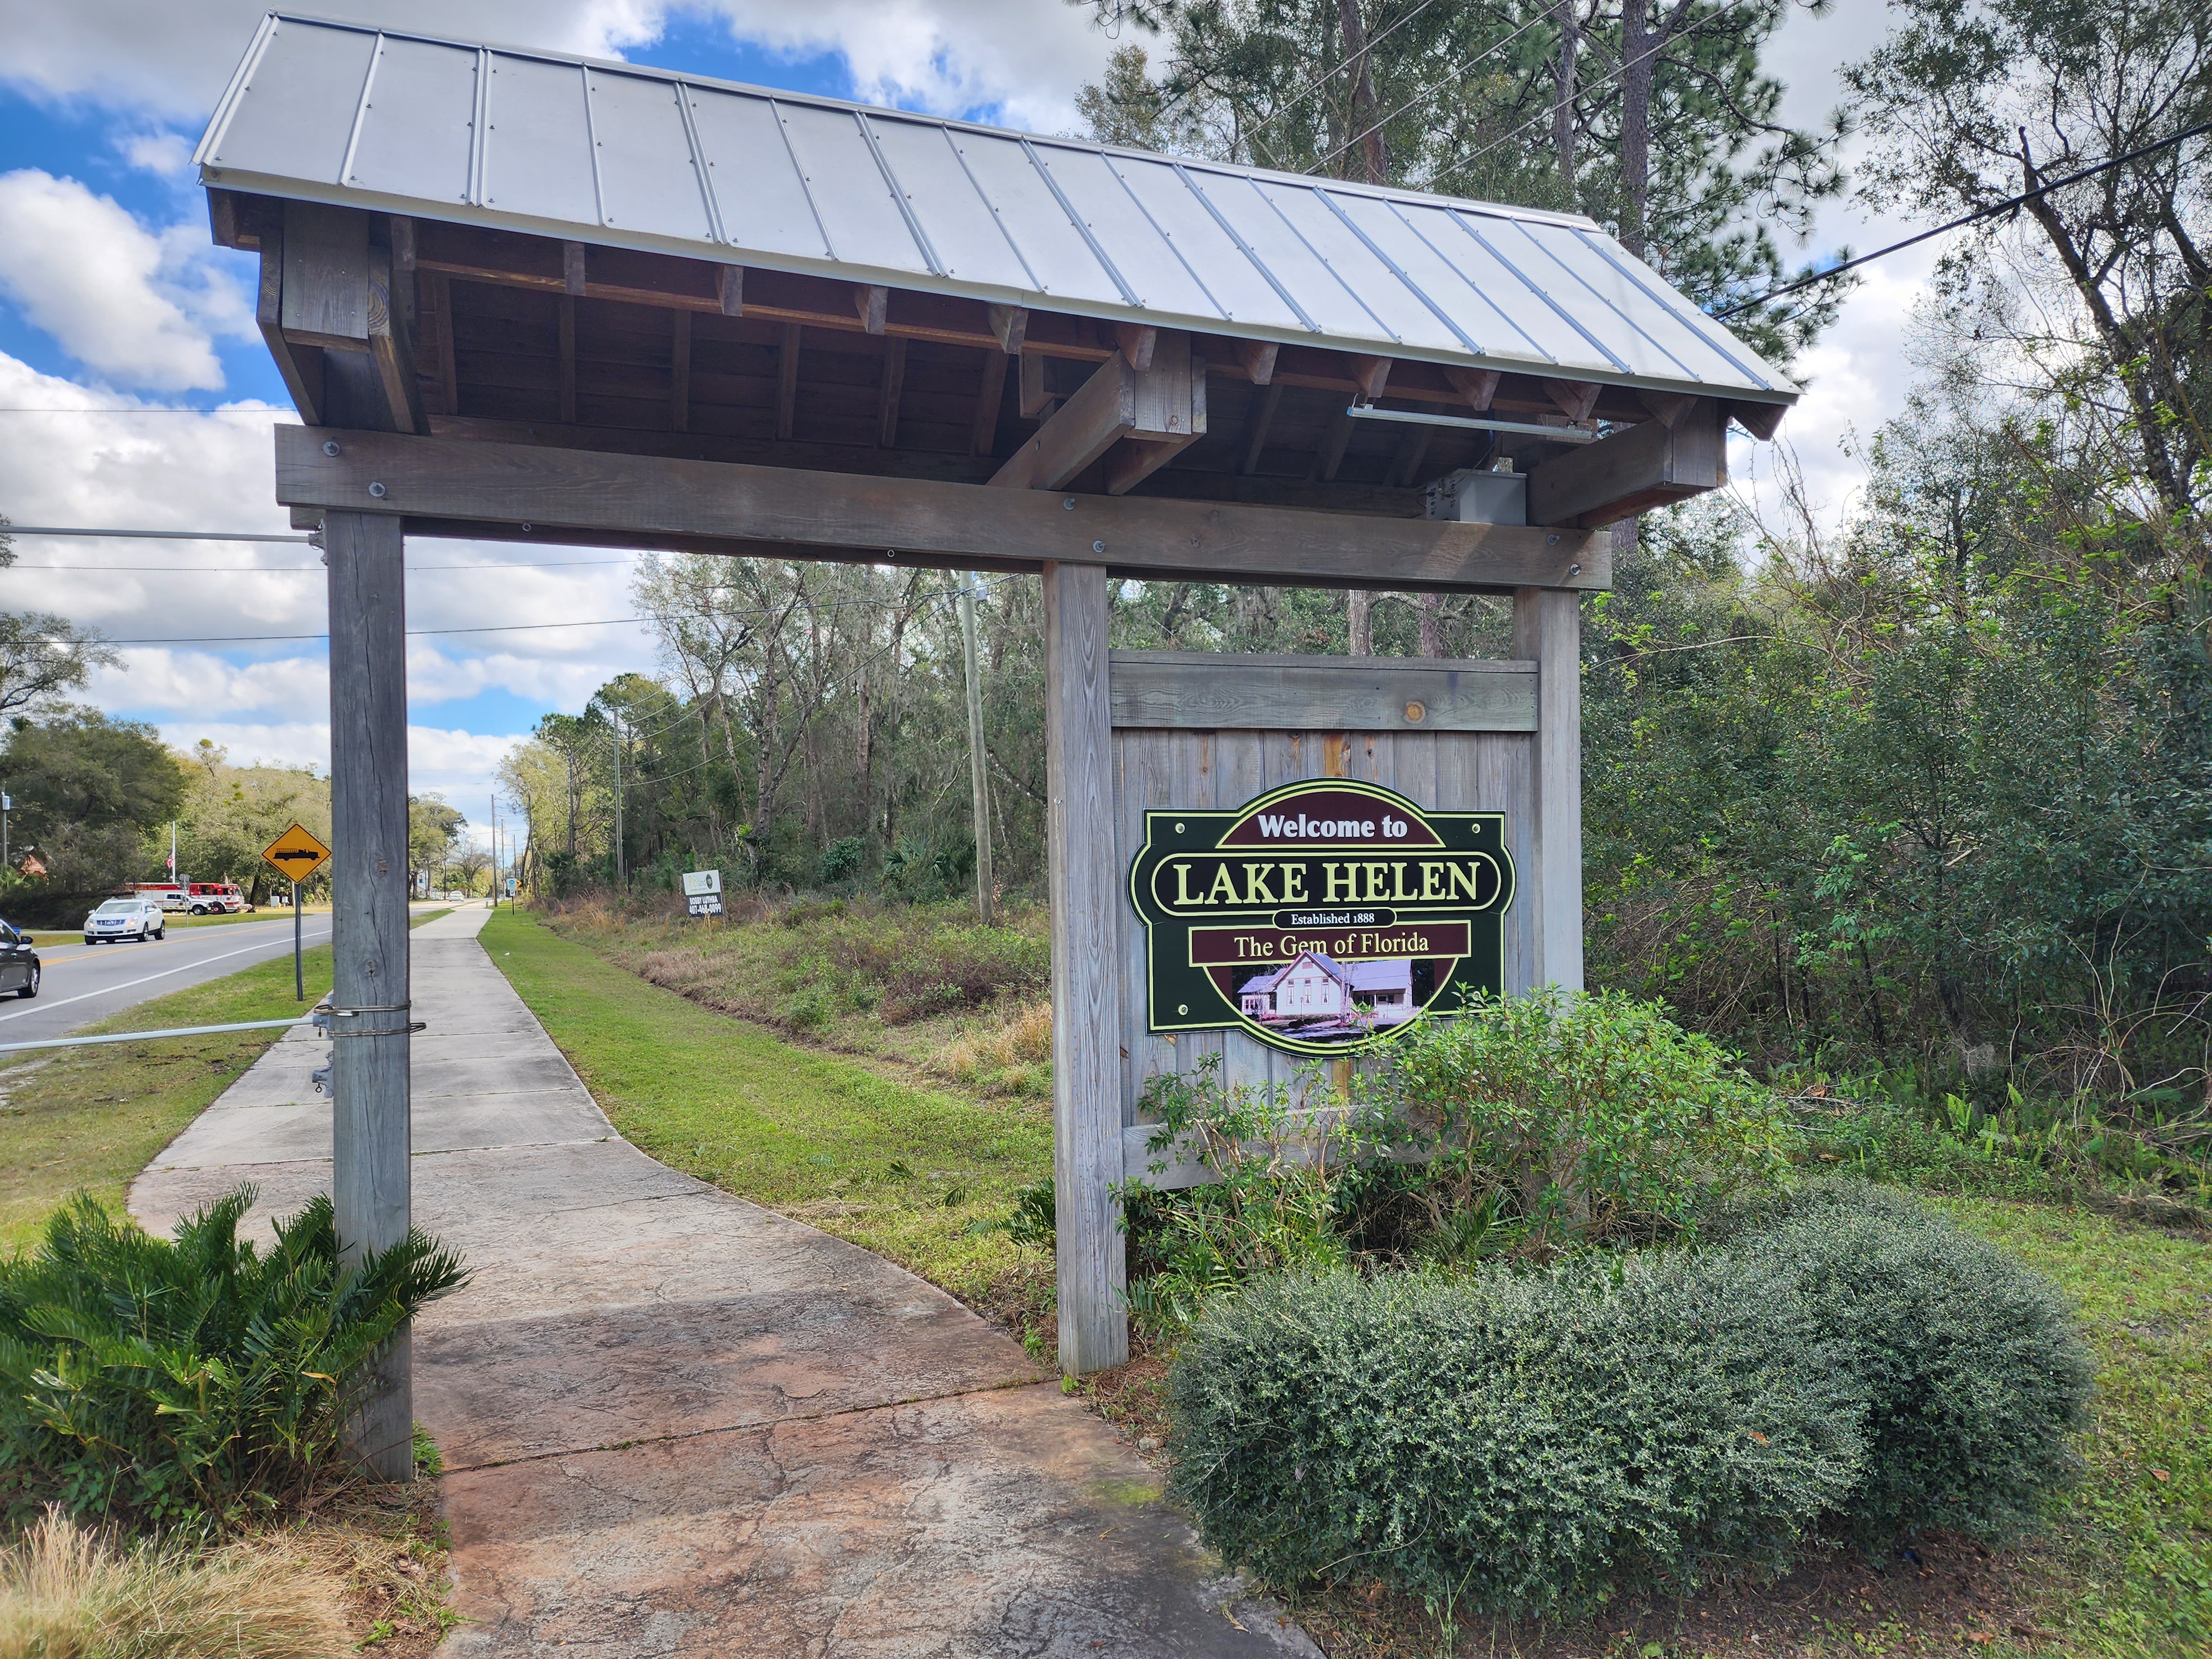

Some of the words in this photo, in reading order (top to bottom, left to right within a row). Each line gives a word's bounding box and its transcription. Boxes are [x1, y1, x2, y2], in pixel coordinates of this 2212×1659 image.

[1257, 813, 1375, 838] Welcome
[1381, 815, 1408, 838] to
[1172, 862, 1309, 905] LAKE
[1322, 862, 1481, 902] HELEN
[689, 902, 722, 915] 407-468-0099
[702, 895, 718, 904] LUTHRA
[1291, 913, 1350, 925] Established
[1353, 912, 1375, 923] 1888
[1234, 936, 1274, 958] The
[1280, 935, 1328, 956] Gem
[1334, 933, 1357, 954] of
[1360, 931, 1430, 953] Florida
